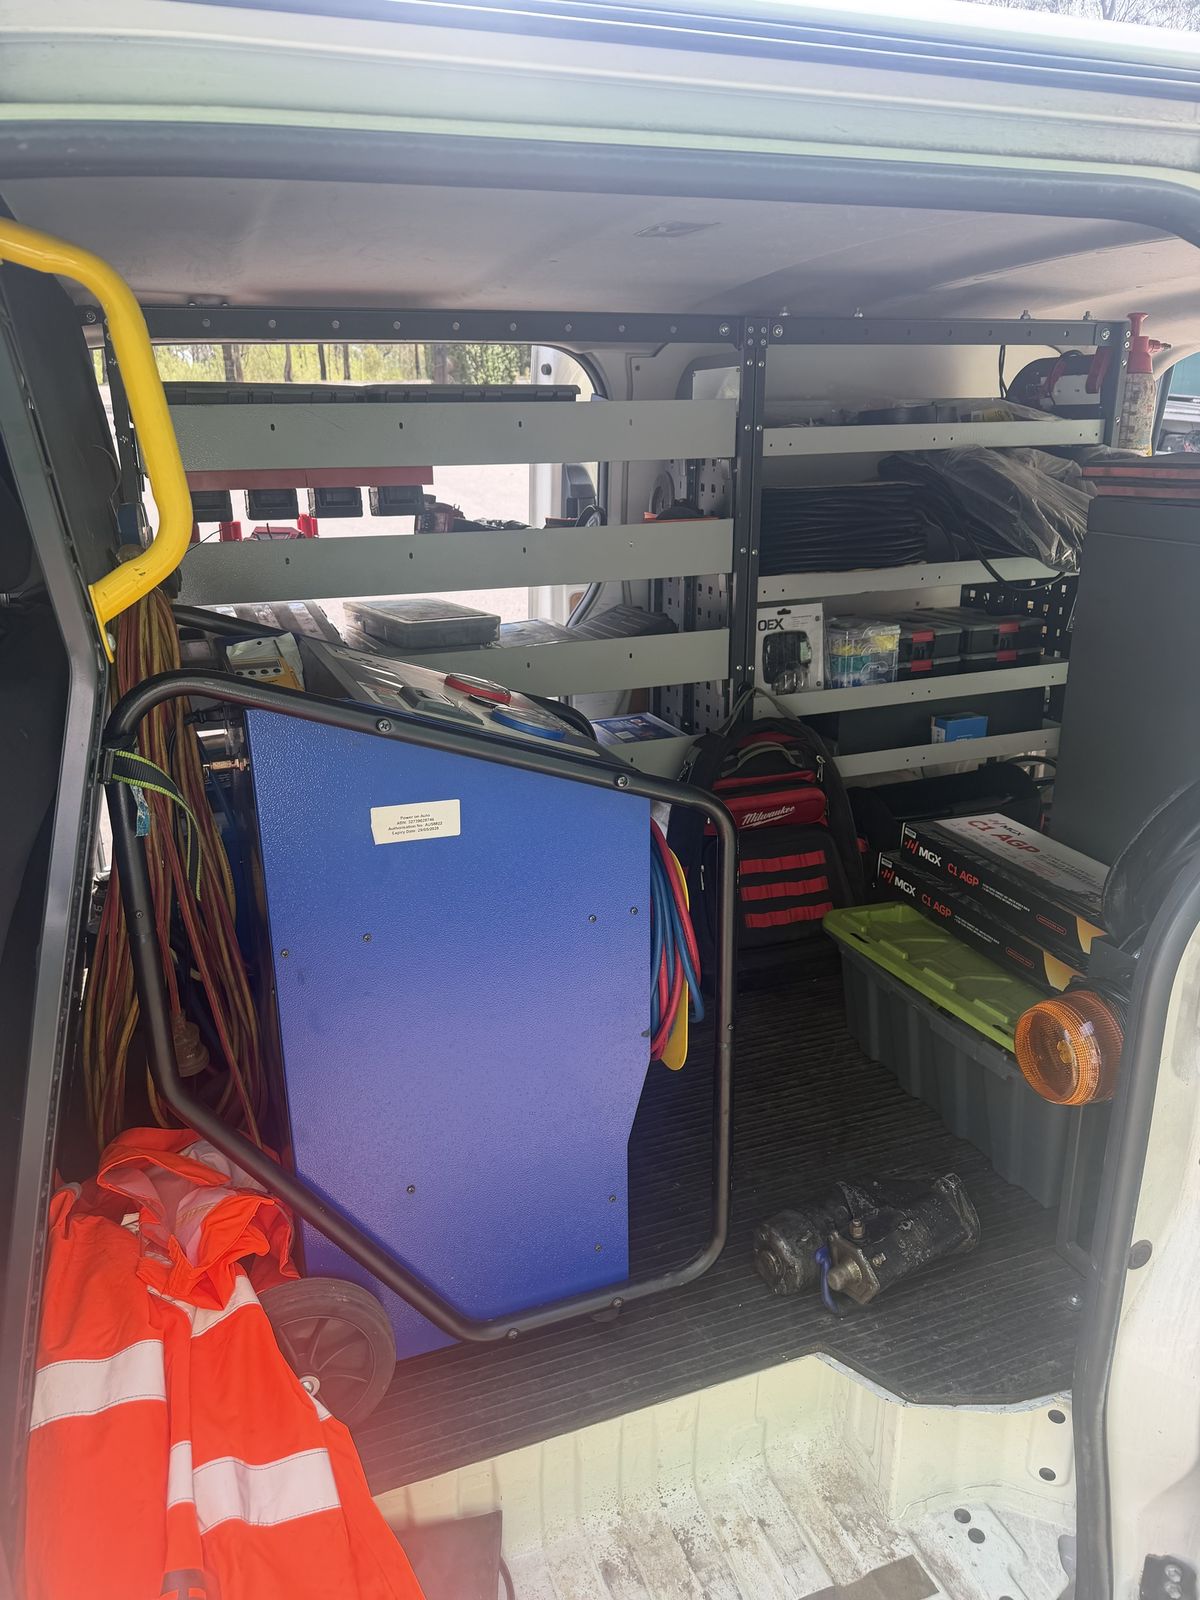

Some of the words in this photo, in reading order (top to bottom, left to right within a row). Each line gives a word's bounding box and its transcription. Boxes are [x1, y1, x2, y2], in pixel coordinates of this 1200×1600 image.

[757, 618, 784, 631] OEX
[741, 805, 795, 826] Milwaukee
[968, 821, 996, 831] C1
[990, 834, 1040, 853] AGP
[919, 846, 941, 867] MGX
[947, 863, 958, 876] C1
[959, 870, 979, 887] AGP
[894, 876, 917, 896] MGX
[921, 893, 931, 907] C1
[933, 901, 952, 917] AGP
